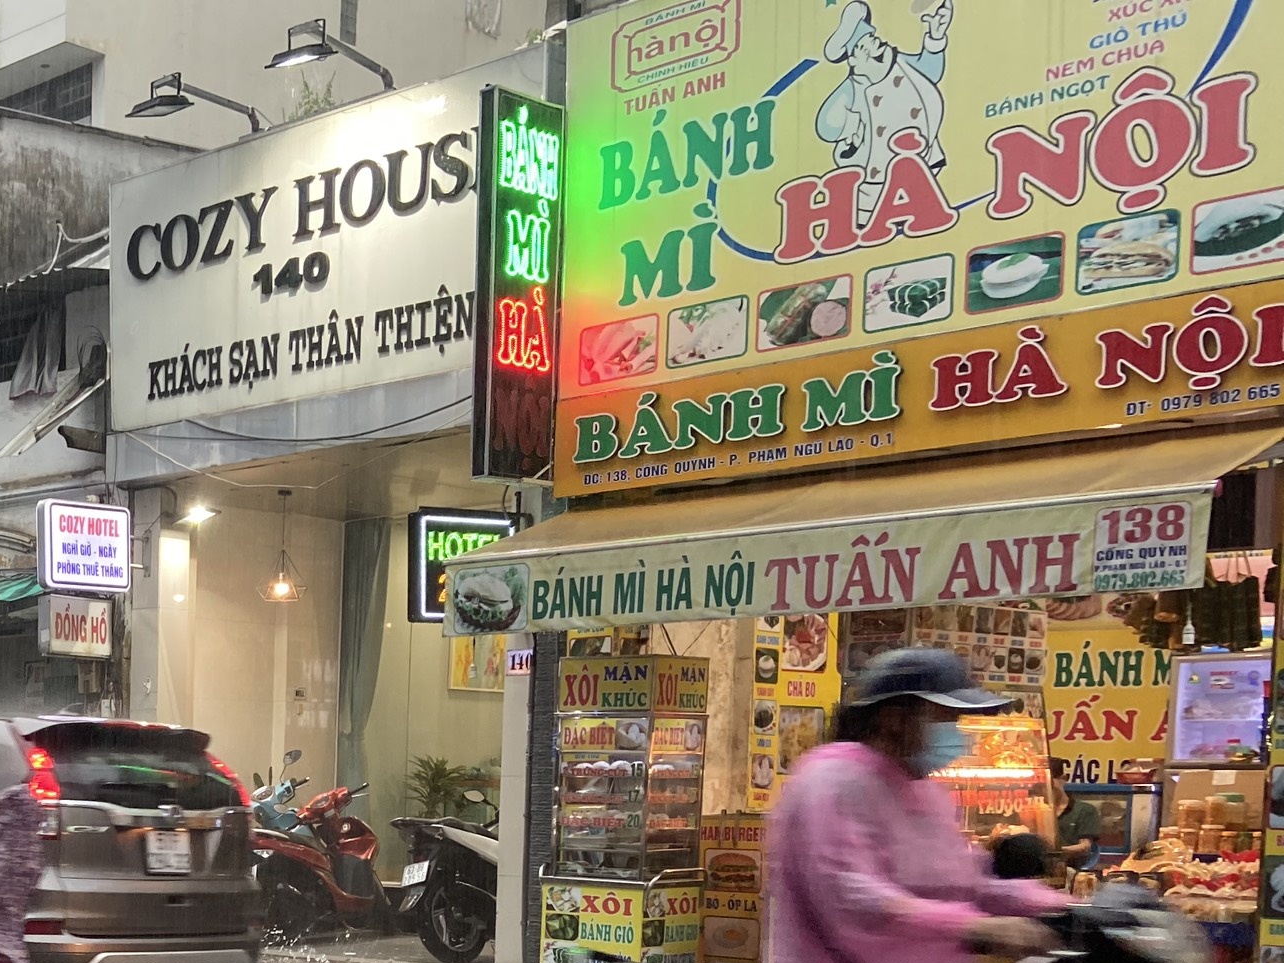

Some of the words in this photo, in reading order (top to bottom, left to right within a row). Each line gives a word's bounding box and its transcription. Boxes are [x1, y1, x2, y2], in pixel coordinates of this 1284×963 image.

[1045, 56, 1095, 82] NEM
[1101, 39, 1165, 67] CHUA
[624, 84, 676, 116] TUẤN
[682, 71, 726, 99] ANH
[984, 91, 1044, 118] BÁNH
[1051, 75, 1111, 102] NGỌT
[497, 104, 560, 201] BÁNH
[597, 98, 776, 211] BÁNH
[126, 185, 279, 281] COZY
[291, 126, 478, 238] HOUS
[618, 202, 719, 306] MÌ
[774, 126, 960, 265] HÀ
[986, 66, 1259, 219] NỘI
[505, 197, 552, 284] MÌ
[253, 250, 331, 296] 140
[147, 343, 223, 400] KHÁCH
[229, 332, 280, 389] SẠN
[288, 309, 365, 372] THÂN
[374, 284, 476, 354] THIỆN
[496, 286, 551, 373] HÀ
[572, 383, 786, 464] BÁNH
[800, 350, 901, 433] MÌ
[929, 325, 1069, 411] HÀ
[1095, 293, 1284, 391] NỘI
[1161, 394, 1204, 413] 0979
[1209, 387, 1242, 406] 802
[1248, 383, 1281, 401] 665
[729, 453, 741, 466] P.
[748, 447, 788, 464] PHẠM
[870, 432, 893, 448] Q.1
[58, 514, 86, 535] COZY
[87, 517, 120, 538] HOTEL
[1102, 504, 1186, 545] 138
[57, 560, 81, 576] PHÒNG
[82, 562, 99, 577] THUÊ
[101, 565, 124, 579] THÁNG
[98, 545, 118, 559] NGÀY
[1139, 543, 1188, 560] QUỲNH
[531, 566, 604, 621] BÁNH
[612, 559, 646, 616] MÌ
[655, 554, 693, 612] HÀ
[703, 549, 757, 616] NỘI
[764, 530, 922, 612] TUẤN
[937, 532, 1082, 600] ANH
[1094, 569, 1186, 591] 0979.802.665
[562, 663, 600, 707] XÔI
[603, 661, 649, 684] MẶN
[656, 663, 679, 707] XÔI
[680, 662, 706, 686] MẶN
[1053, 641, 1145, 688] BÁNH
[1151, 649, 1171, 687] M
[600, 687, 648, 708] KHÚC
[678, 687, 705, 709] KHÚC
[1047, 694, 1138, 742] UẤN
[563, 722, 587, 749] ĐẶC
[588, 720, 615, 750] BIỆT
[630, 762, 644, 777] 15
[627, 813, 640, 828] 20
[580, 891, 633, 917] XÔI
[665, 891, 698, 916] XÔI
[579, 918, 611, 943] BÁNH
[614, 921, 634, 945] GIÒ
